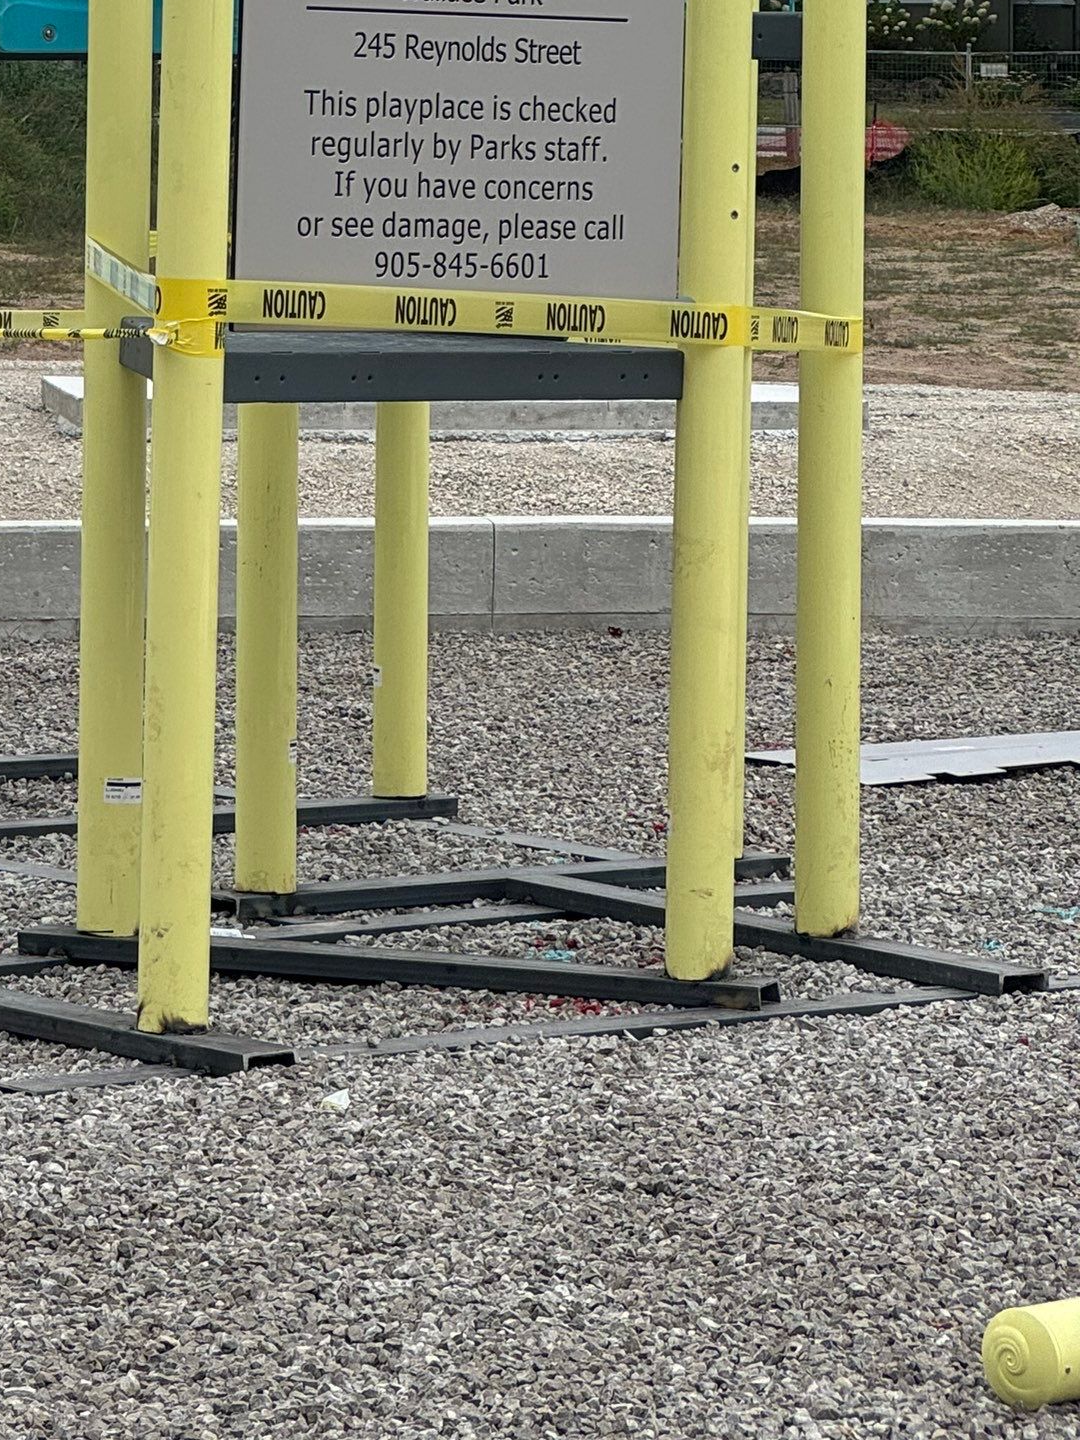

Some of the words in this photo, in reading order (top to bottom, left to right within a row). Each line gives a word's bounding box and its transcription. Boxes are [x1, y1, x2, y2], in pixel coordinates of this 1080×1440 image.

[353, 31, 397, 59] 245
[405, 33, 507, 67] Reynolds
[514, 37, 582, 66] Street
[303, 88, 357, 117] This
[366, 90, 484, 125] playplace
[493, 94, 512, 121] is
[518, 94, 617, 124] checked
[311, 130, 425, 165] regularly
[432, 130, 460, 166] by
[470, 133, 537, 161] Parks
[544, 135, 607, 163] staff.
[334, 170, 357, 197] If
[363, 177, 408, 204] you
[417, 171, 476, 200] have
[484, 179, 593, 201] concerns
[297, 216, 324, 237] or
[331, 216, 374, 238] see
[382, 210, 489, 245] damage,
[498, 212, 576, 246] please
[584, 214, 624, 241] call
[374, 251, 549, 279] 905-845-6601
[262, 288, 327, 319] CAUTION
[394, 294, 457, 327] CAUTION
[545, 302, 606, 333] CAUTION
[670, 308, 728, 340] CAUTION
[771, 315, 799, 343] CAUTION
